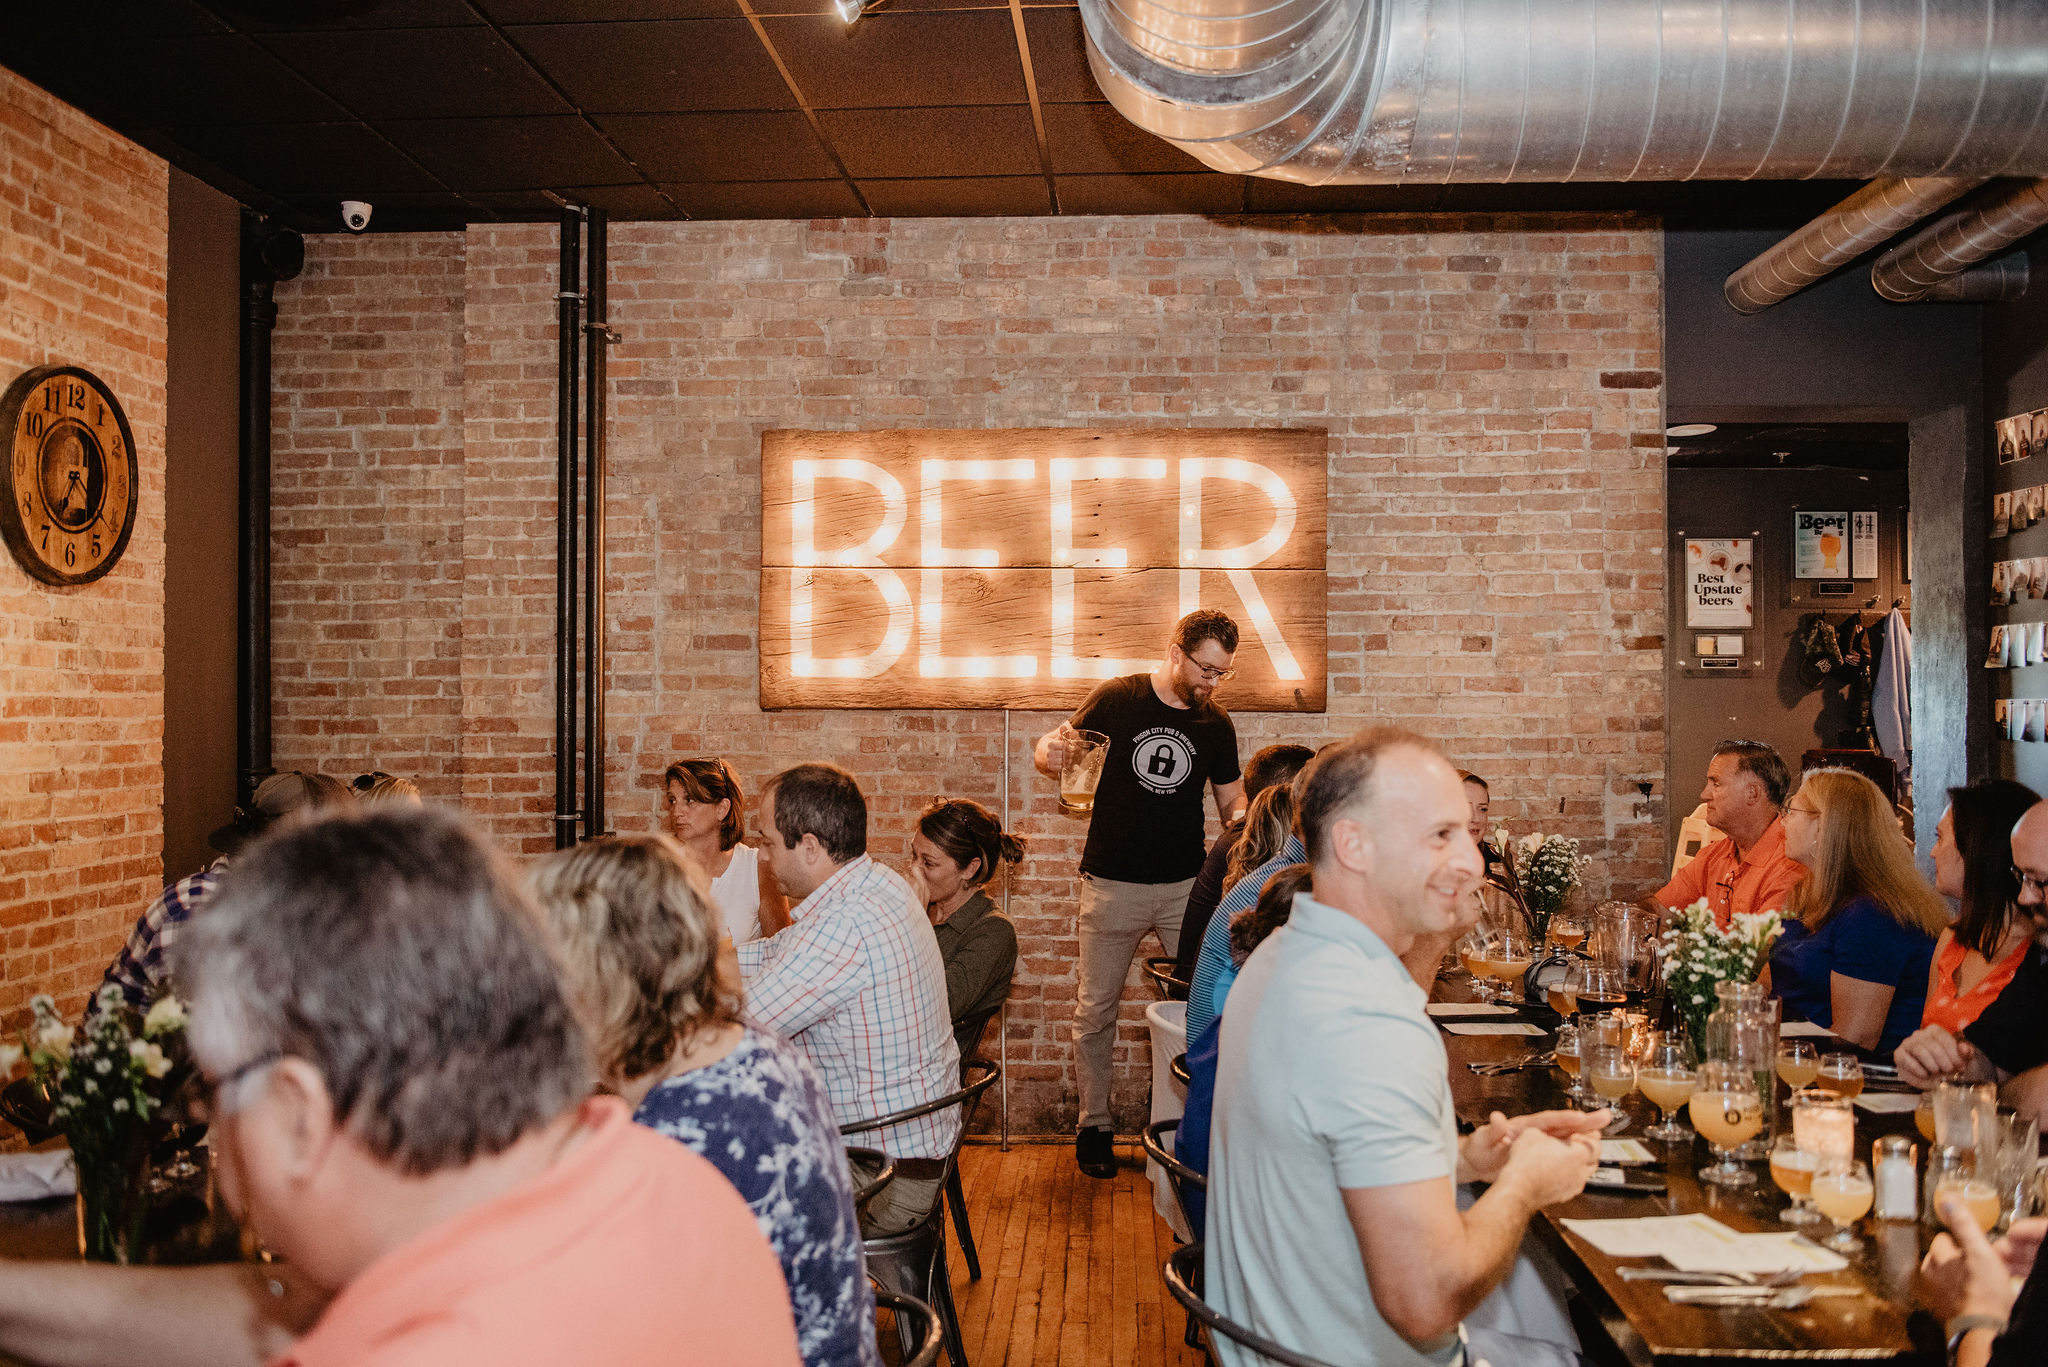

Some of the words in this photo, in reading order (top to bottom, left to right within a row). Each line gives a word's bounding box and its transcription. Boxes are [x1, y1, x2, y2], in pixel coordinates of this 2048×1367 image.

[43, 386, 61, 415] 11
[67, 383, 86, 410] 12
[25, 411, 43, 439] 10
[96, 403, 105, 427] 1
[112, 434, 122, 460] 2
[16, 450, 26, 477] 9
[116, 474, 128, 500] 3
[22, 491, 32, 517] 8
[1799, 514, 1846, 530] Beer
[40, 525, 51, 550] 7
[91, 534, 102, 559] 5
[64, 542, 76, 568] 6
[790, 456, 1306, 682] BEER
[1697, 573, 1725, 584] Best
[1694, 584, 1742, 596] Upstate
[1698, 595, 1734, 606] beers
[1132, 730, 1150, 743] PRISON
[1179, 733, 1197, 755] BREWERY
